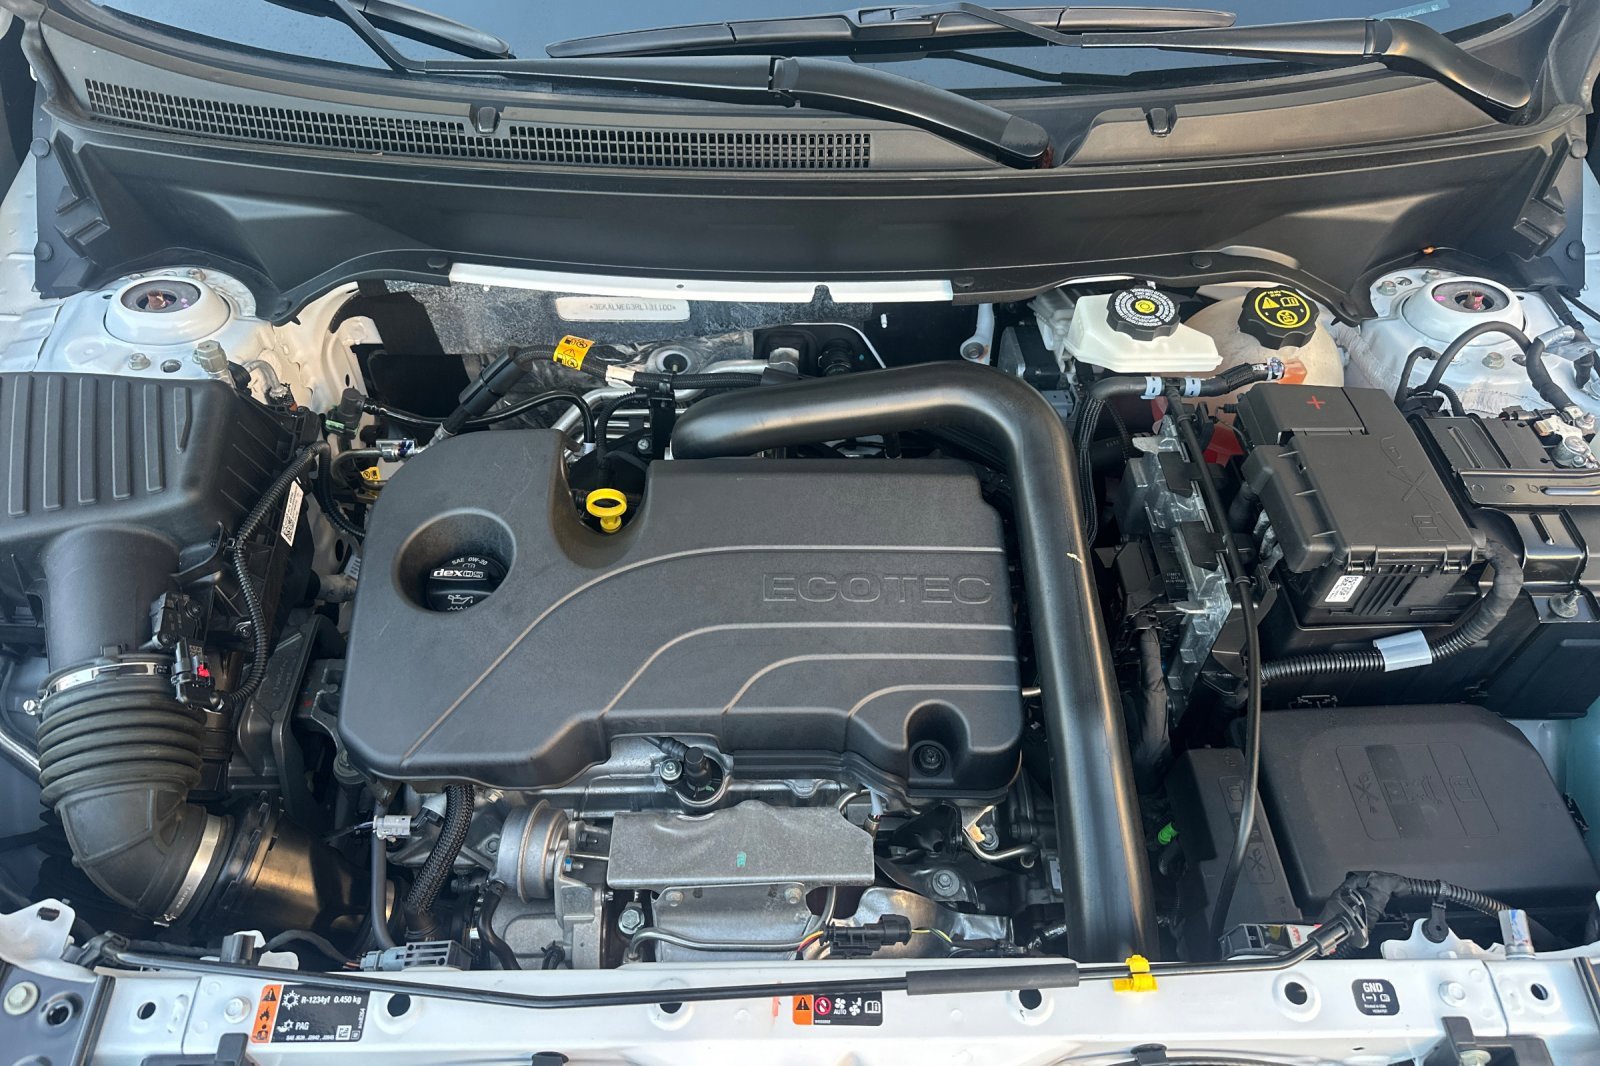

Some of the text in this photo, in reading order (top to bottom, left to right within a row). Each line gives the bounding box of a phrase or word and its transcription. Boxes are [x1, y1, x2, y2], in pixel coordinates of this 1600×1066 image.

[468, 557, 488, 565] 0W-20
[763, 573, 992, 604] ECOTEC
[1362, 982, 1384, 993] GND
[333, 995, 352, 1004] 0.450
[352, 995, 362, 1005] kg
[295, 1022, 310, 1030] PAG
